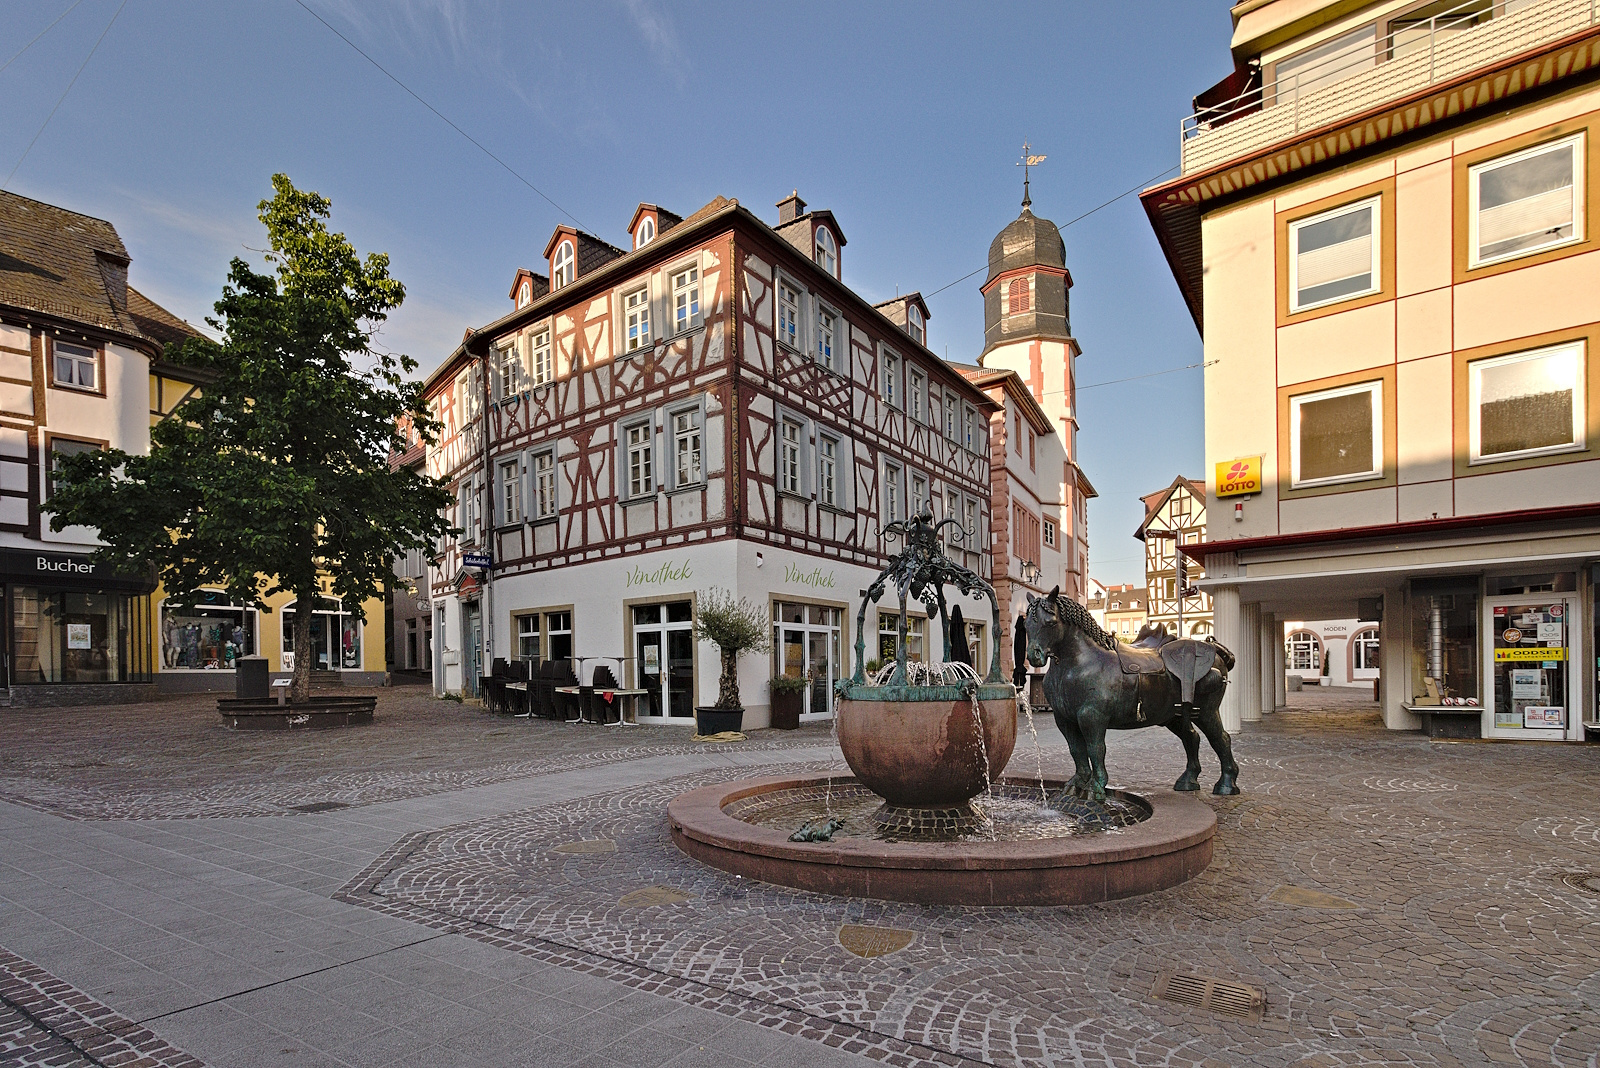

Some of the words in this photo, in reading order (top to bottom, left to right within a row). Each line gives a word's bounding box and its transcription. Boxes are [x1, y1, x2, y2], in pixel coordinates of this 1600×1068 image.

[1220, 480, 1255, 493] LOTTO
[36, 556, 96, 574] Bucher
[626, 558, 693, 588] Vinothek
[784, 561, 836, 589] Vinothek
